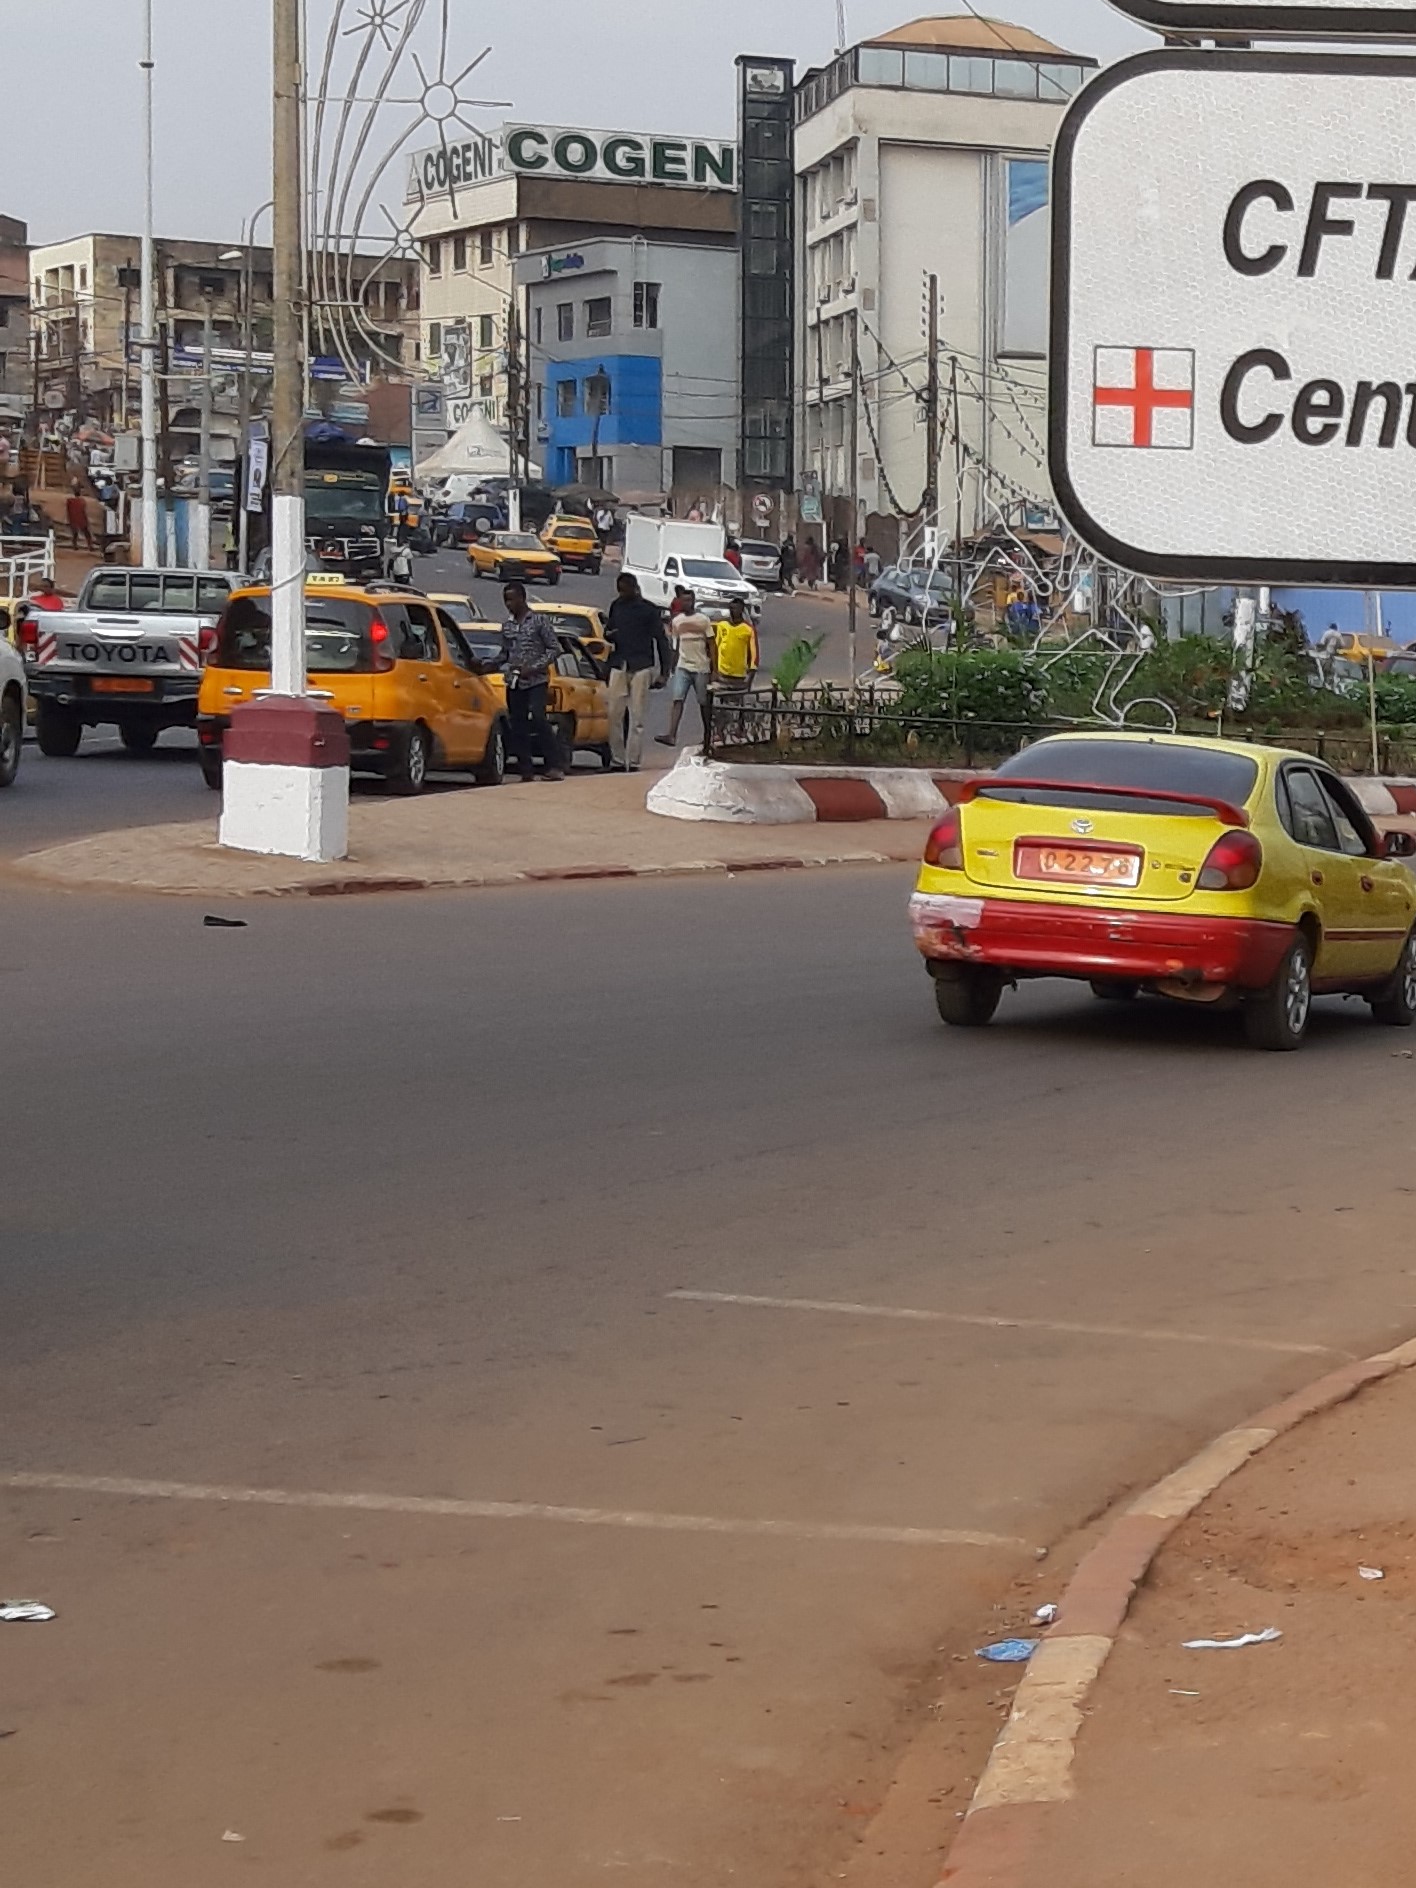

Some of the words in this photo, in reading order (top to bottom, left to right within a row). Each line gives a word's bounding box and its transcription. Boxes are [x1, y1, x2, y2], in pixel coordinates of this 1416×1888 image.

[507, 130, 735, 185] COGEN
[453, 399, 496, 424] CONI
[65, 643, 171, 662] TOYOTA
